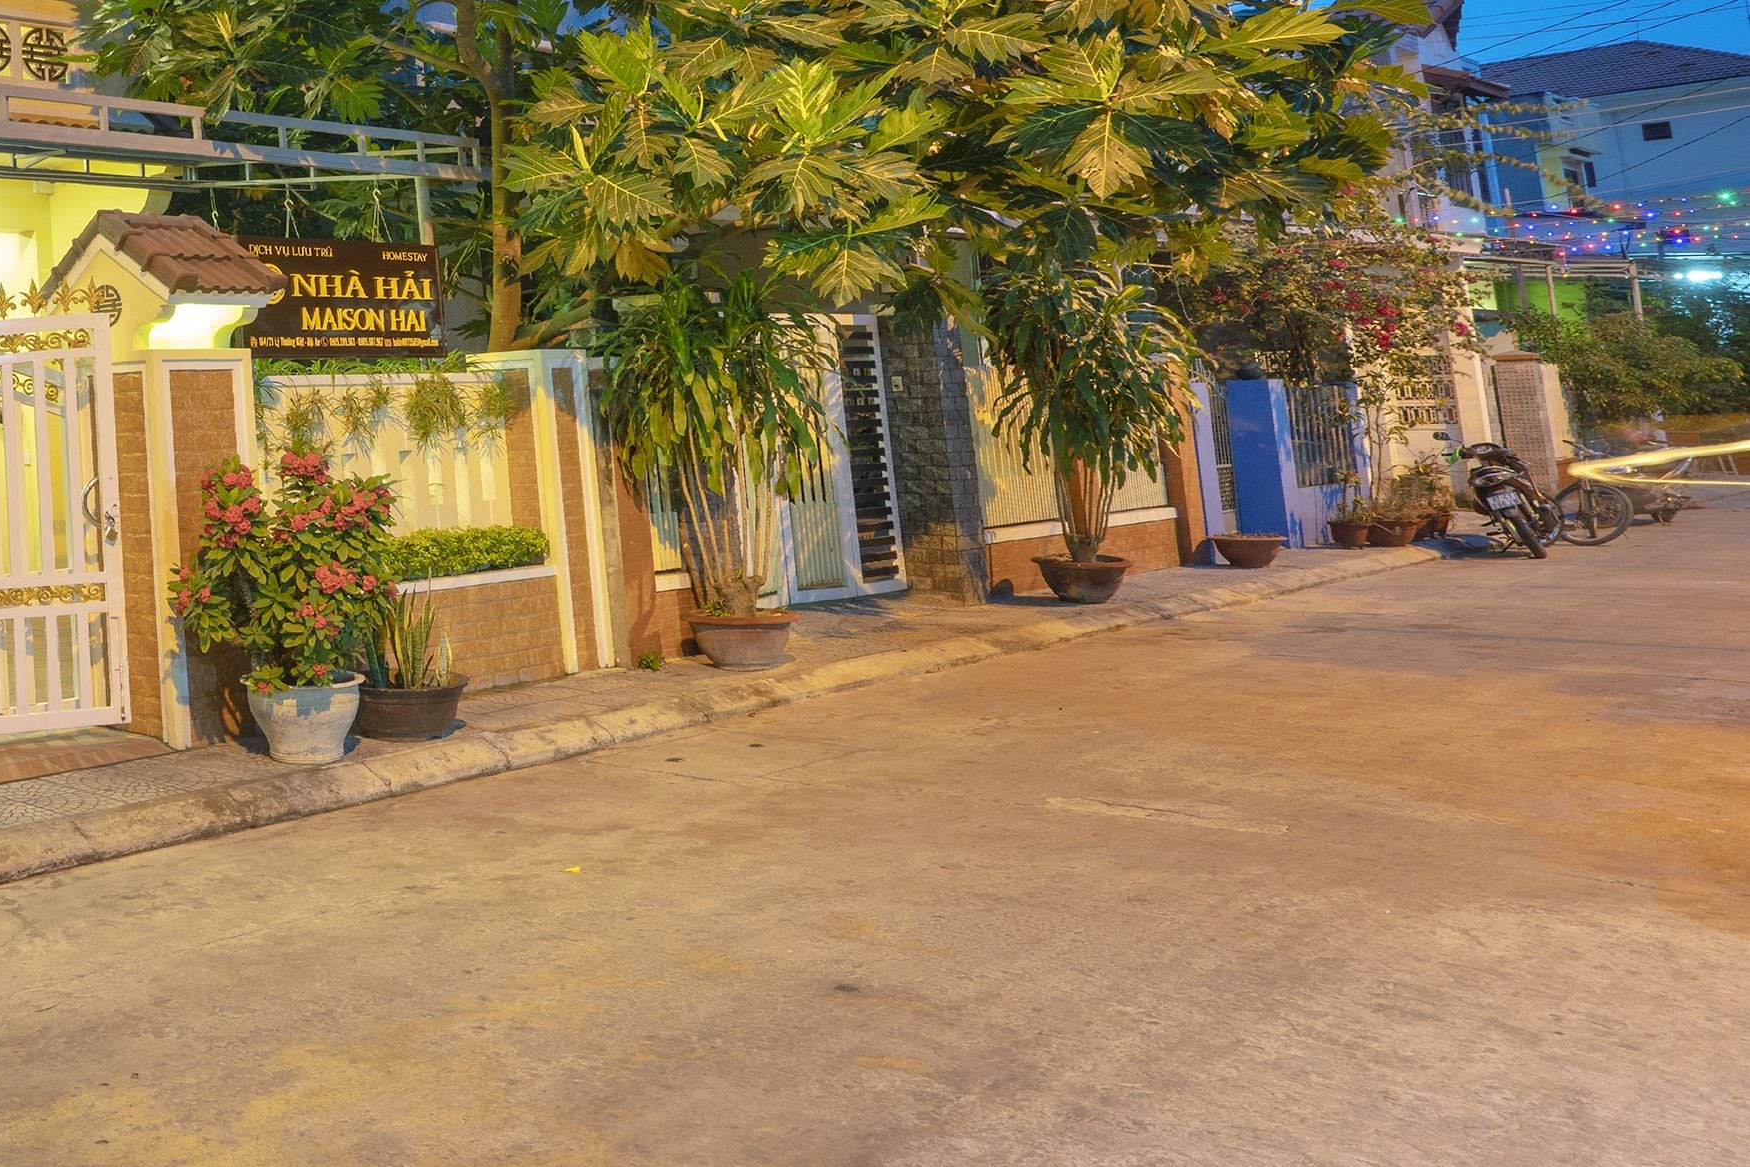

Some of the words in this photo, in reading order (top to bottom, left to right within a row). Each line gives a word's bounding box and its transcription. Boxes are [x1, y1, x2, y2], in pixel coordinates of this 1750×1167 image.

[382, 251, 428, 262] HOMESTAY
[290, 269, 369, 299] NHÀ
[373, 270, 433, 301] HẢI
[301, 307, 385, 332] MAISON
[390, 309, 426, 332] HAI
